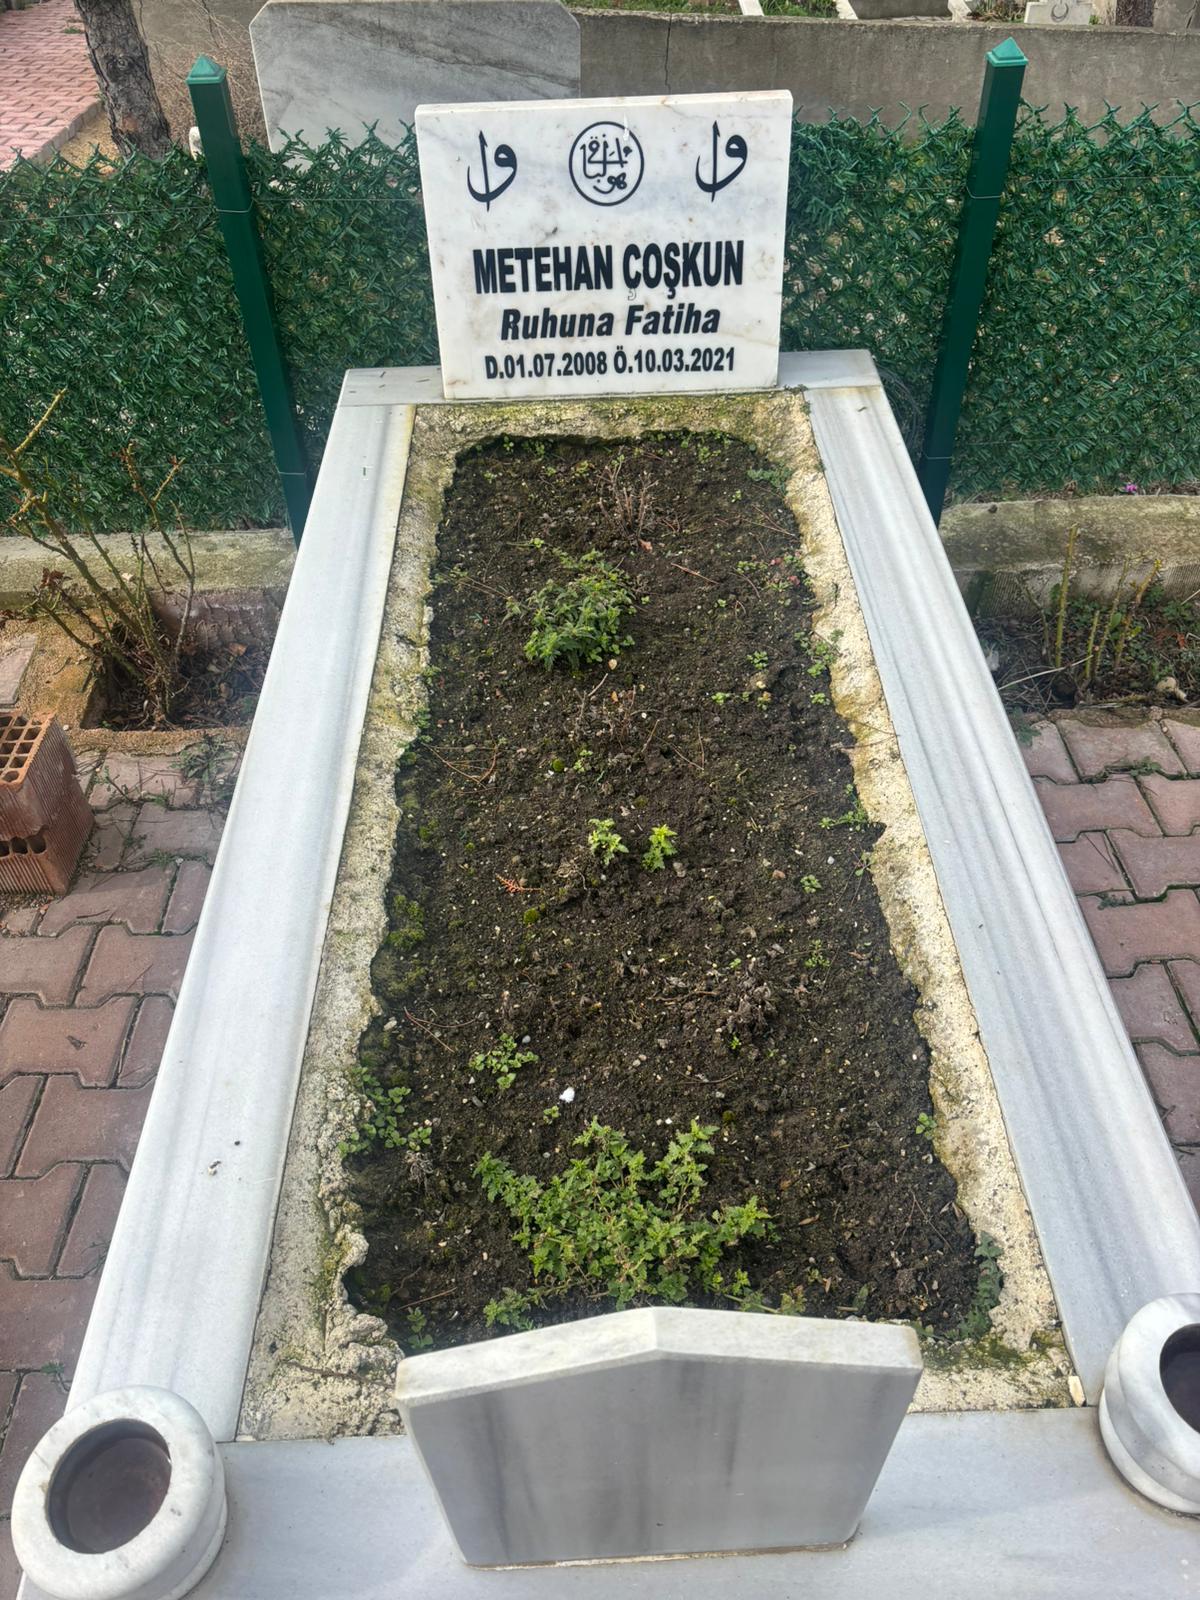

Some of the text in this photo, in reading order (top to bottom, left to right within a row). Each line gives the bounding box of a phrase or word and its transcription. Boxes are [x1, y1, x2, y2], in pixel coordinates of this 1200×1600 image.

[472, 240, 744, 300] METEHAN COŞKUN
[500, 302, 721, 341] Ruhuna Fatiha
[484, 345, 735, 380] D.01.07.2008 Ö.10.03.2021
